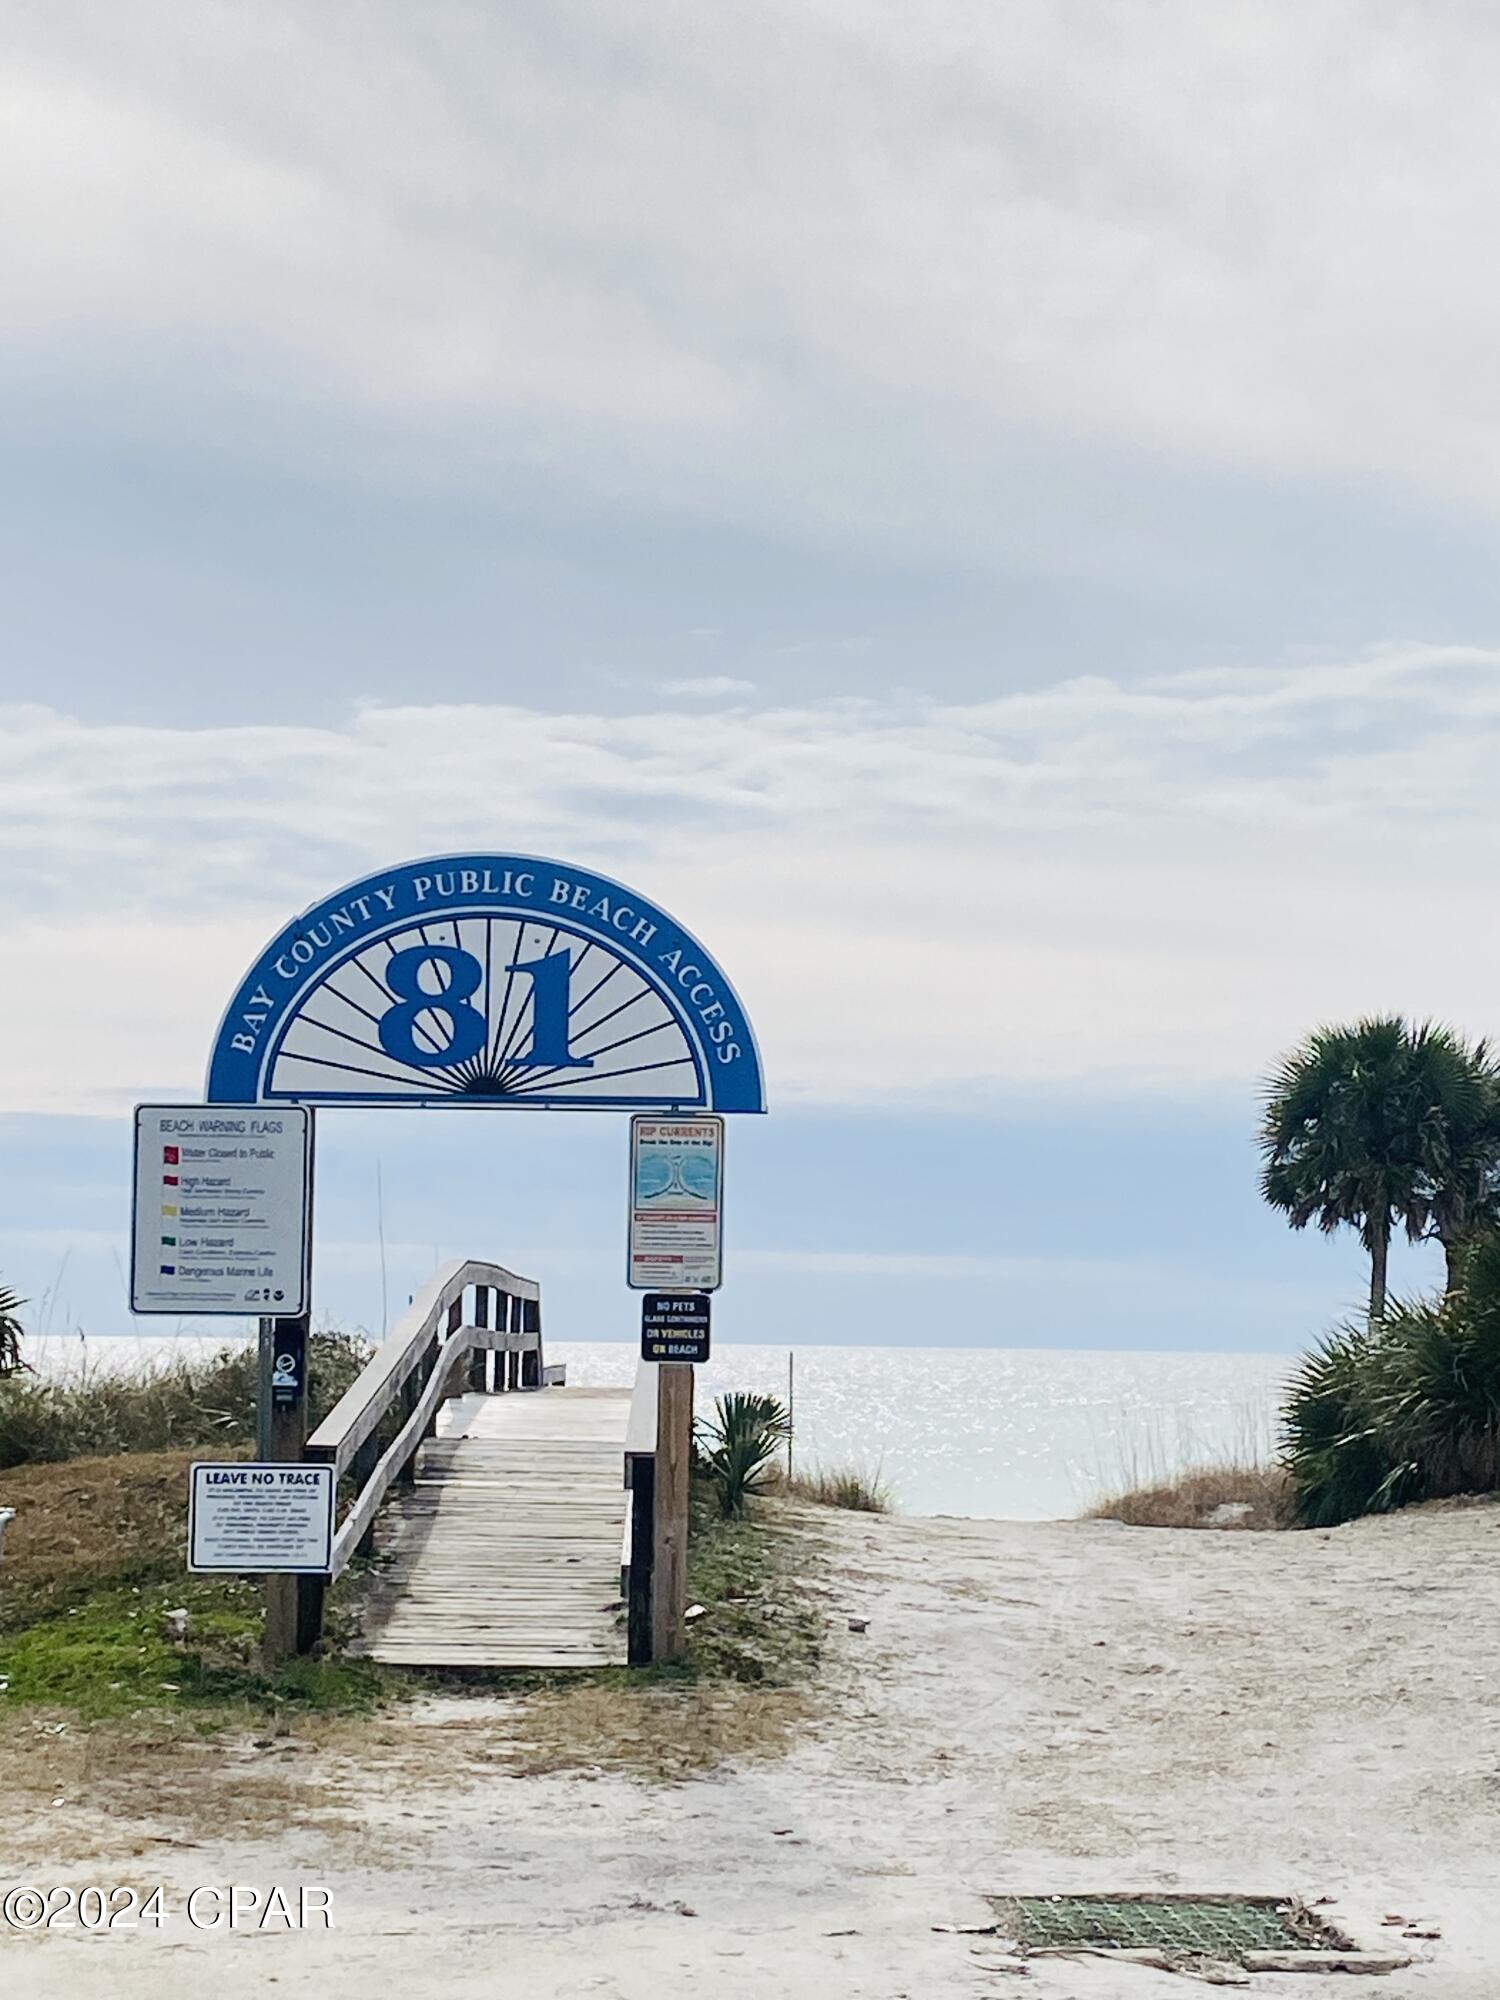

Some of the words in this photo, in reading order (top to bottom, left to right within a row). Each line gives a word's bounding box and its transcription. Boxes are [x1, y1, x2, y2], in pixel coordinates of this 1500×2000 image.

[231, 984, 275, 1055] BAY
[270, 884, 397, 980] COUNTY
[412, 868, 536, 902] PUBLIC
[549, 877, 659, 949] BEACH
[657, 948, 742, 1065] ACCESS
[377, 944, 595, 1069] 81
[159, 1119, 195, 1133] BEACH
[199, 1119, 246, 1133] WARNING
[250, 1121, 284, 1134] FLAGS
[659, 1126, 715, 1138] CURRENTS
[249, 1149, 275, 1159] Public
[180, 1207, 216, 1217] Medium
[217, 1208, 250, 1217] Hazard
[178, 1237, 198, 1247] Low
[200, 1238, 234, 1247] Hazard
[178, 1266, 225, 1278] Dangerous
[226, 1267, 256, 1277] Marine
[257, 1267, 274, 1277] Life
[656, 1301, 671, 1312] NO
[672, 1302, 696, 1312] PETS
[646, 1328, 660, 1338] OR
[660, 1328, 705, 1339] VEHICLES
[652, 1343, 667, 1354] ON
[668, 1344, 699, 1355] BEACH
[205, 1472, 248, 1485] LEAVE
[251, 1473, 275, 1485] NO
[278, 1473, 321, 1486] TRACE
